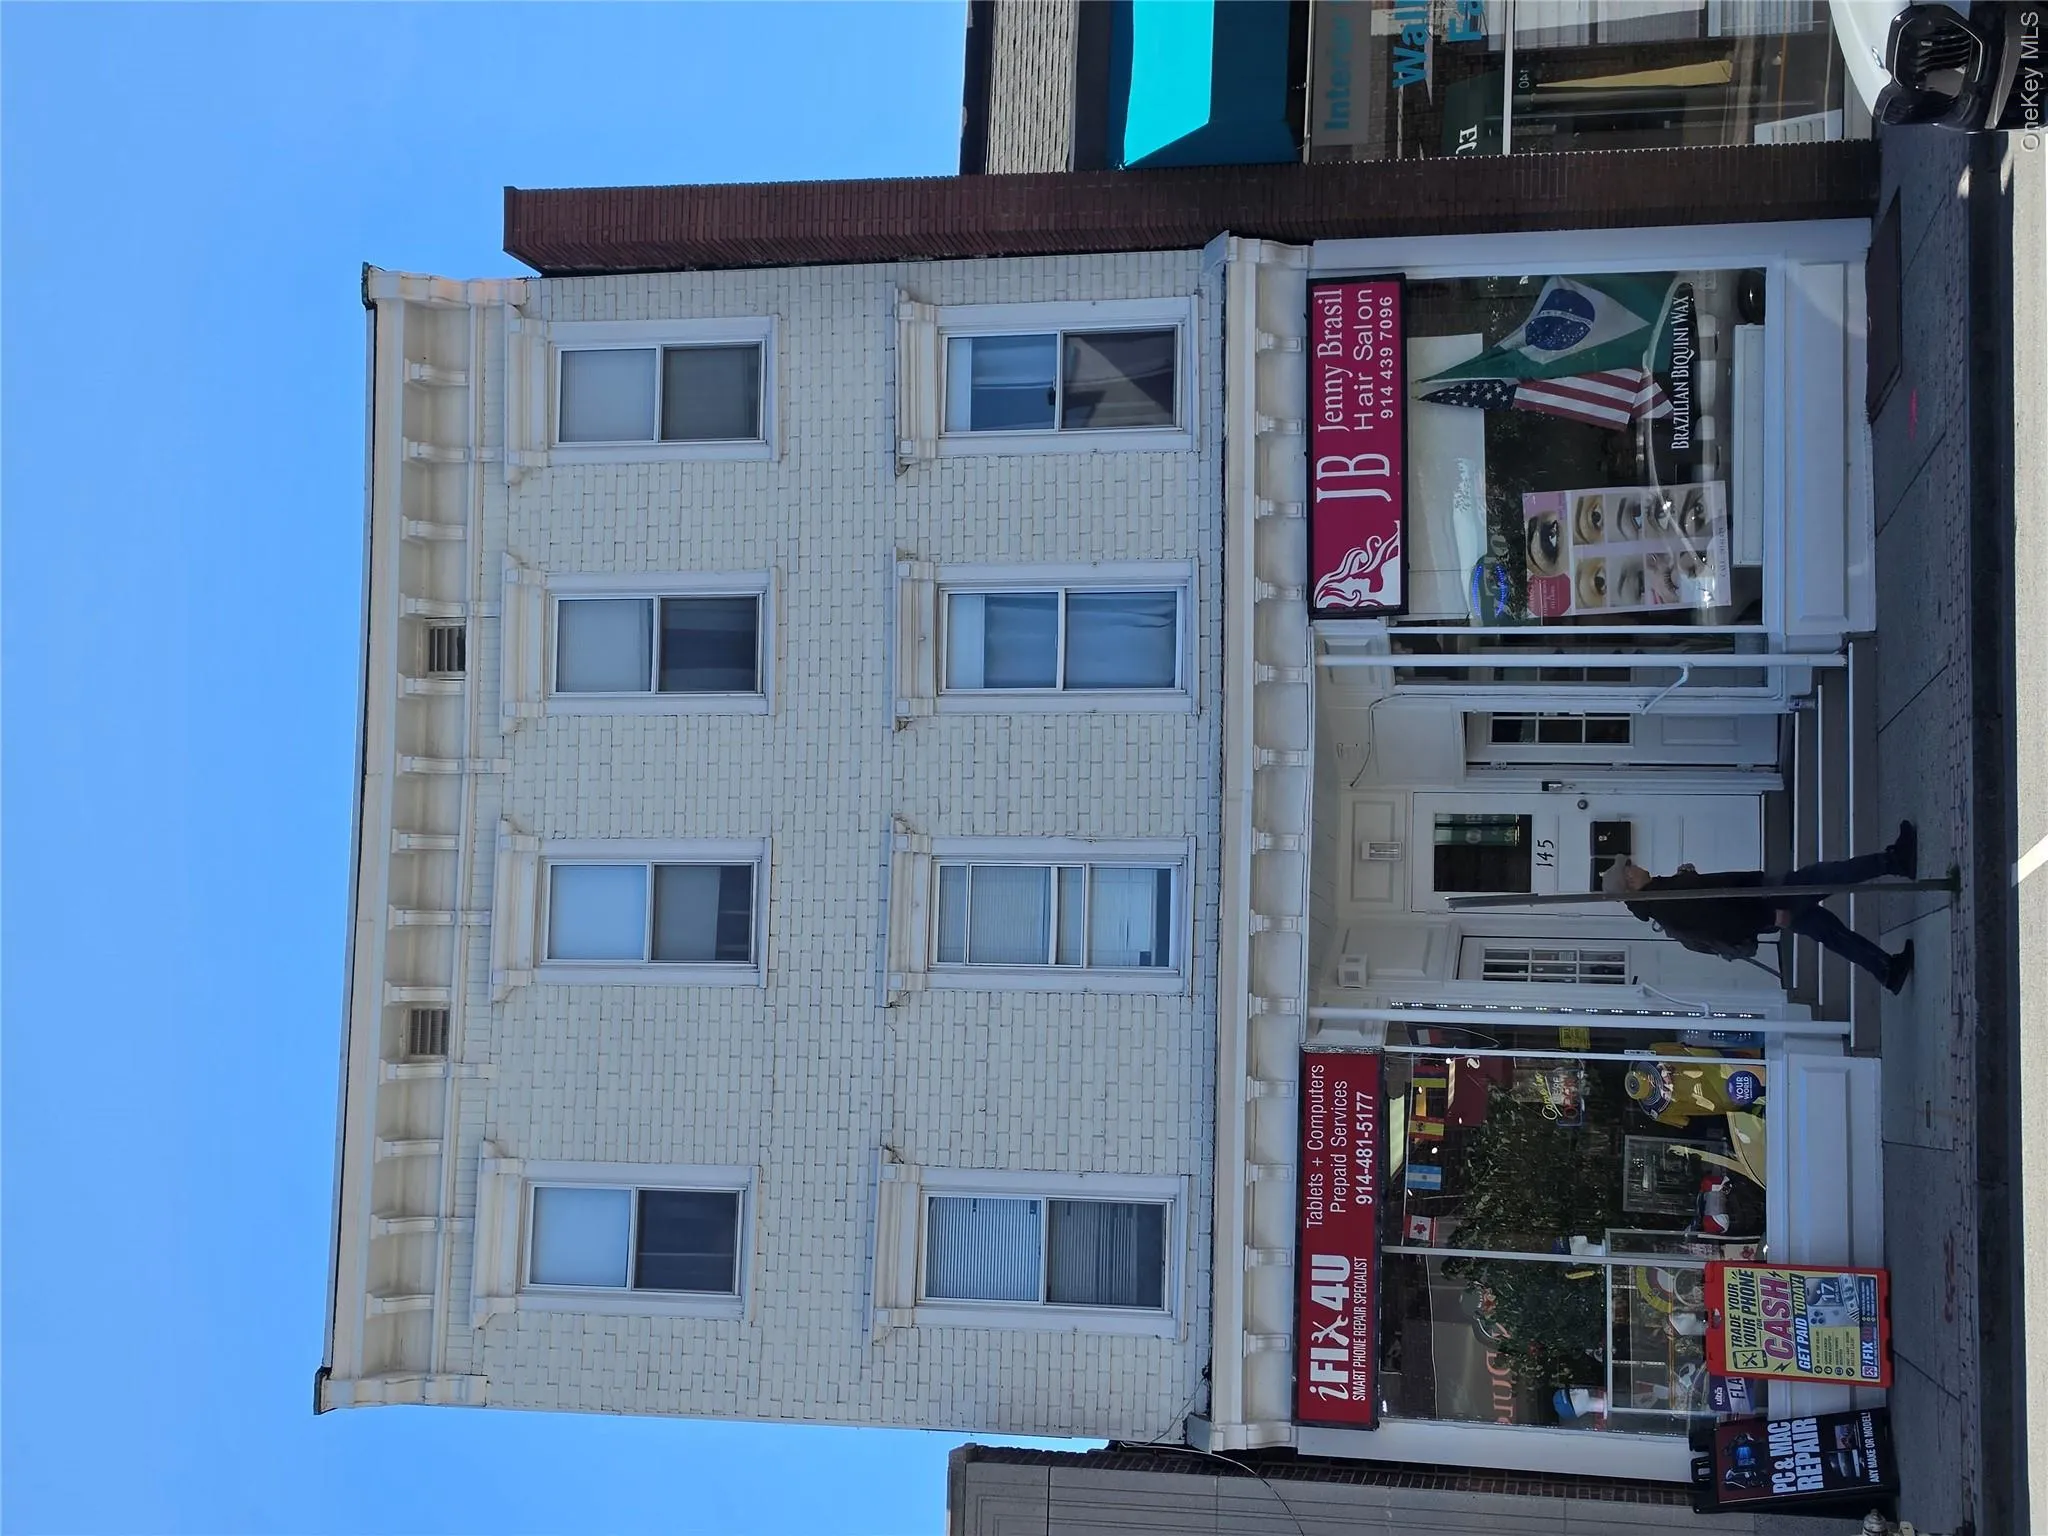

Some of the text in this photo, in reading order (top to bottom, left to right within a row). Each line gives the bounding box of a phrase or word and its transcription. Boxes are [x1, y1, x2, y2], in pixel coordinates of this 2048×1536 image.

[1313, 288, 1353, 432] Jenny Brasil
[1353, 289, 1374, 430] Hair Salon
[1379, 296, 1393, 418] 914 439 7096
[1316, 453, 1392, 503] JB
[1536, 840, 1554, 868] 145
[1306, 1064, 1327, 1150] Computers
[1736, 1076, 1744, 1100] YOUR
[1330, 1080, 1350, 1213] Prepaid Services
[1355, 1091, 1373, 1205] 914-481-5177
[1306, 1173, 1324, 1228] Tablets
[1352, 1256, 1368, 1401] SMART PHONE REPAIR SPECIALIST
[1728, 1283, 1742, 1348] TRADE YOUR
[1739, 1269, 1757, 1348] YOUR PHONE
[1760, 1277, 1794, 1360] CASH
[1792, 1277, 1811, 1369] GET PAID TODAY!
[1820, 1282, 1835, 1301] 17
[1767, 1421, 1796, 1494] PC & MAC
[1791, 1418, 1824, 1490] REPAIR
[1860, 1412, 1880, 1482] ANY MAKE OR MODEL!
